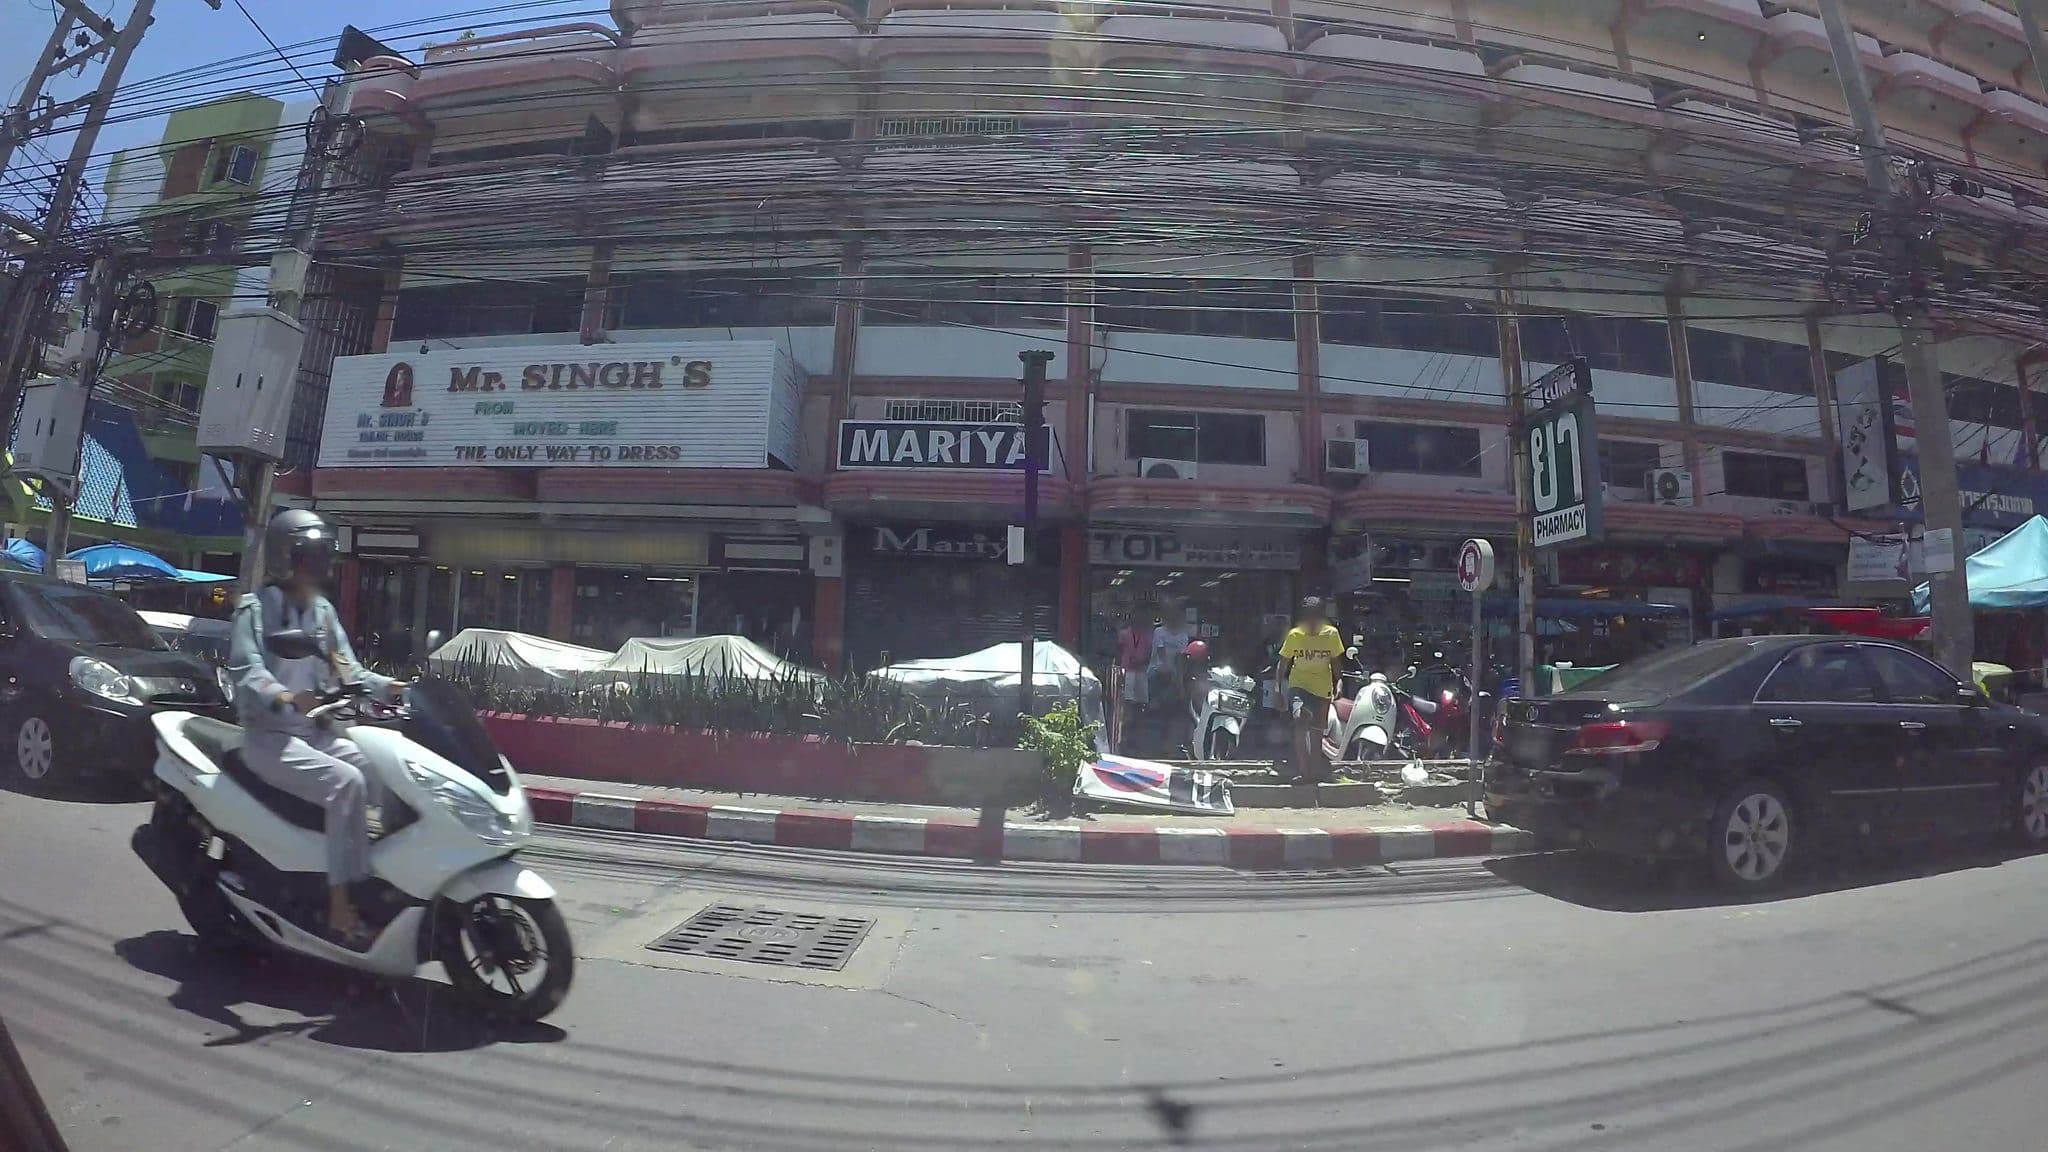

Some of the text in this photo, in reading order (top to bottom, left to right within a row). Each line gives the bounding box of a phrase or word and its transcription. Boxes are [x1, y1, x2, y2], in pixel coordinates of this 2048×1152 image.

[447, 355, 713, 392] Mr. SINGH'S
[474, 401, 515, 416] FROM
[454, 445, 682, 461] THE ONLY WAY TO DRESS
[849, 429, 1026, 465] MARIYA
[1531, 412, 1582, 512] ยา
[1536, 511, 1586, 540] PHARMACY
[1093, 533, 1181, 561] TOP
